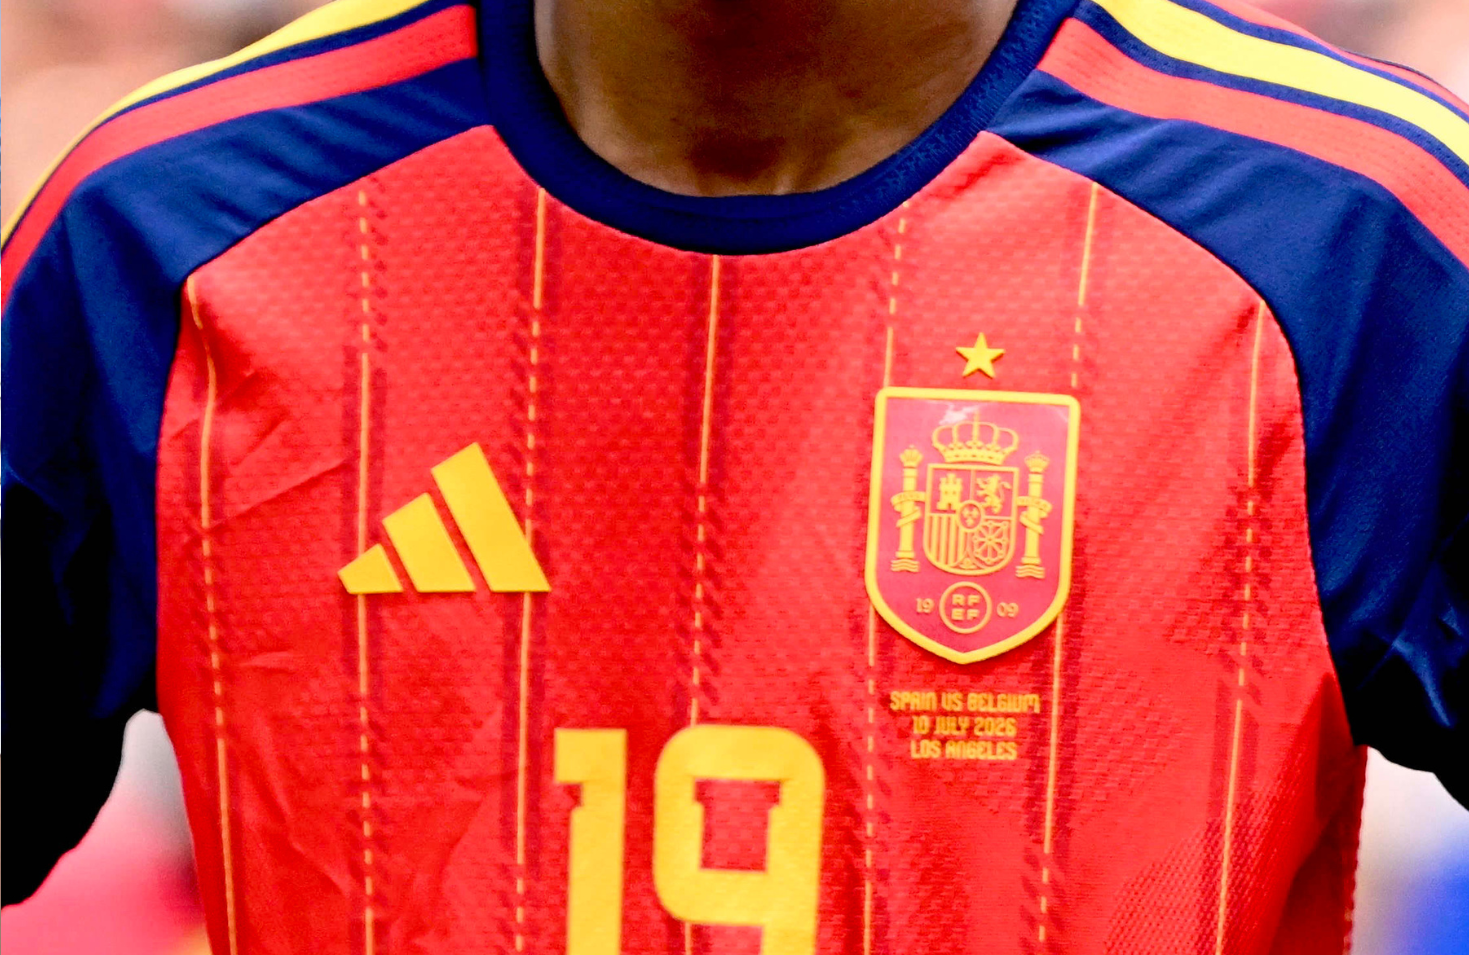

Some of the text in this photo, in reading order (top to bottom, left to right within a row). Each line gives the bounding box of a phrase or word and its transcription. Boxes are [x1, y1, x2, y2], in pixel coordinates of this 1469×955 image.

[915, 598, 934, 613] 19
[996, 602, 1019, 618] 09
[889, 691, 938, 711] SPAIN
[967, 693, 1041, 714] BELGIUM
[912, 715, 1017, 737] 10 JULY 2026
[910, 739, 1018, 760] LOS ANGELES
[554, 724, 825, 955] 19
